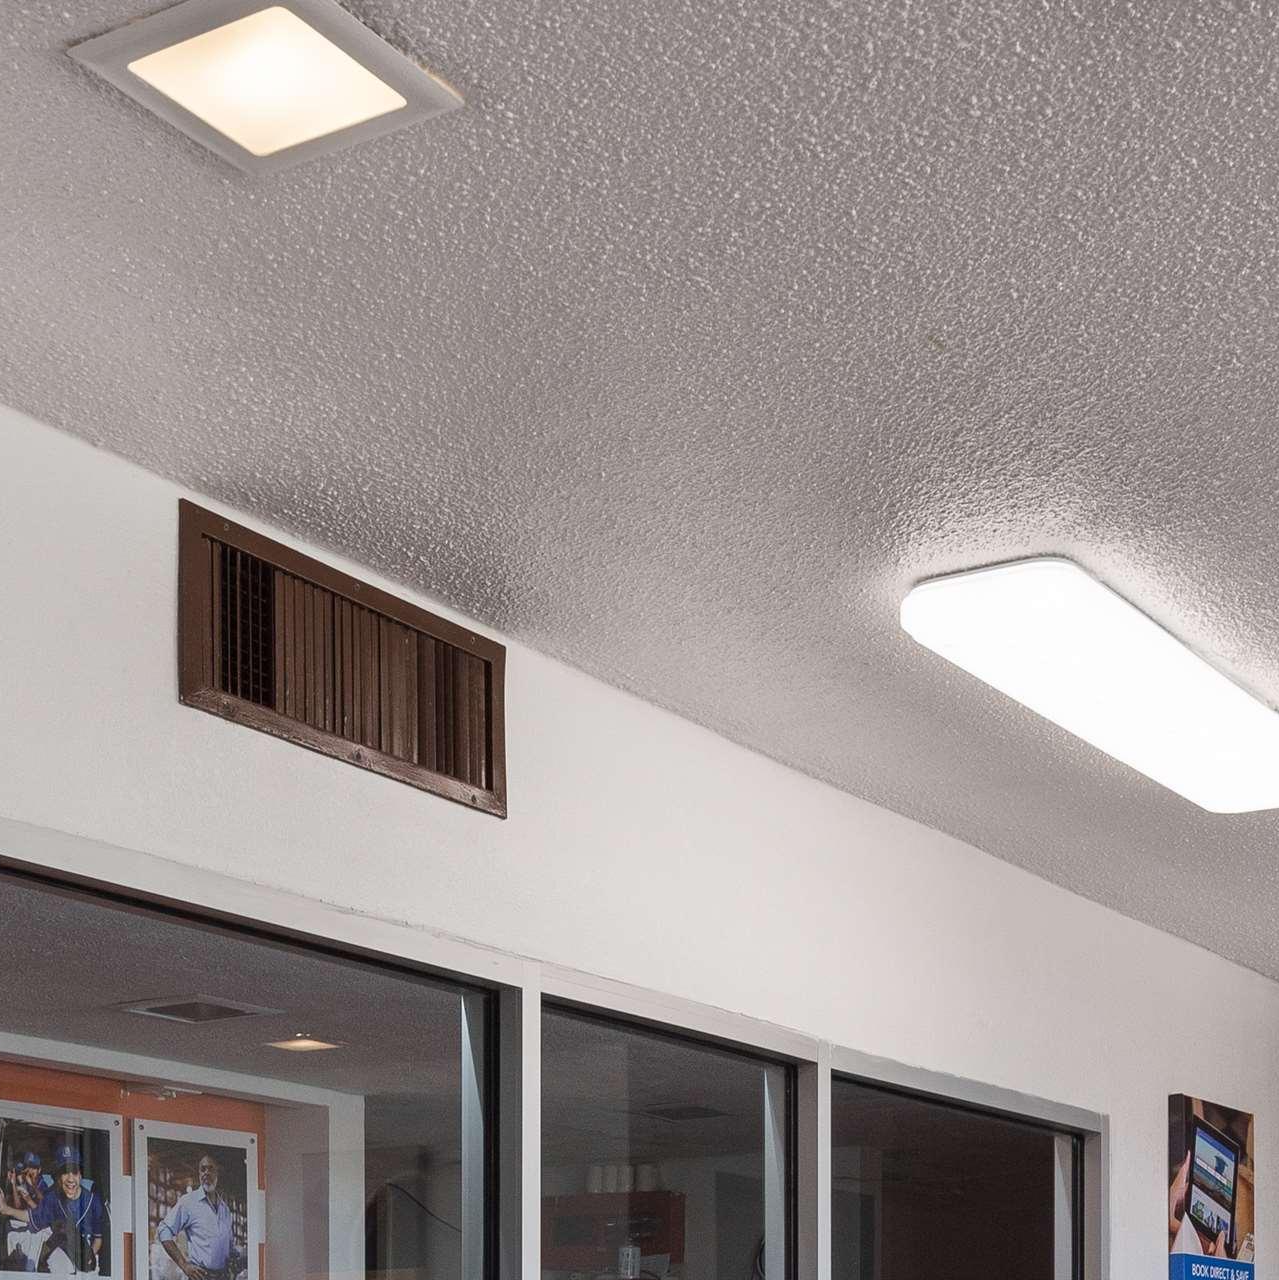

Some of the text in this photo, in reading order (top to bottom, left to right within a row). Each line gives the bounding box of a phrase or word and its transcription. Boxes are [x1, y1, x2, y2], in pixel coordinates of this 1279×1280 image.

[1192, 1263, 1209, 1278] BOOK
[1210, 1266, 1229, 1280] DIRECT
[1230, 1269, 1236, 1280] &
